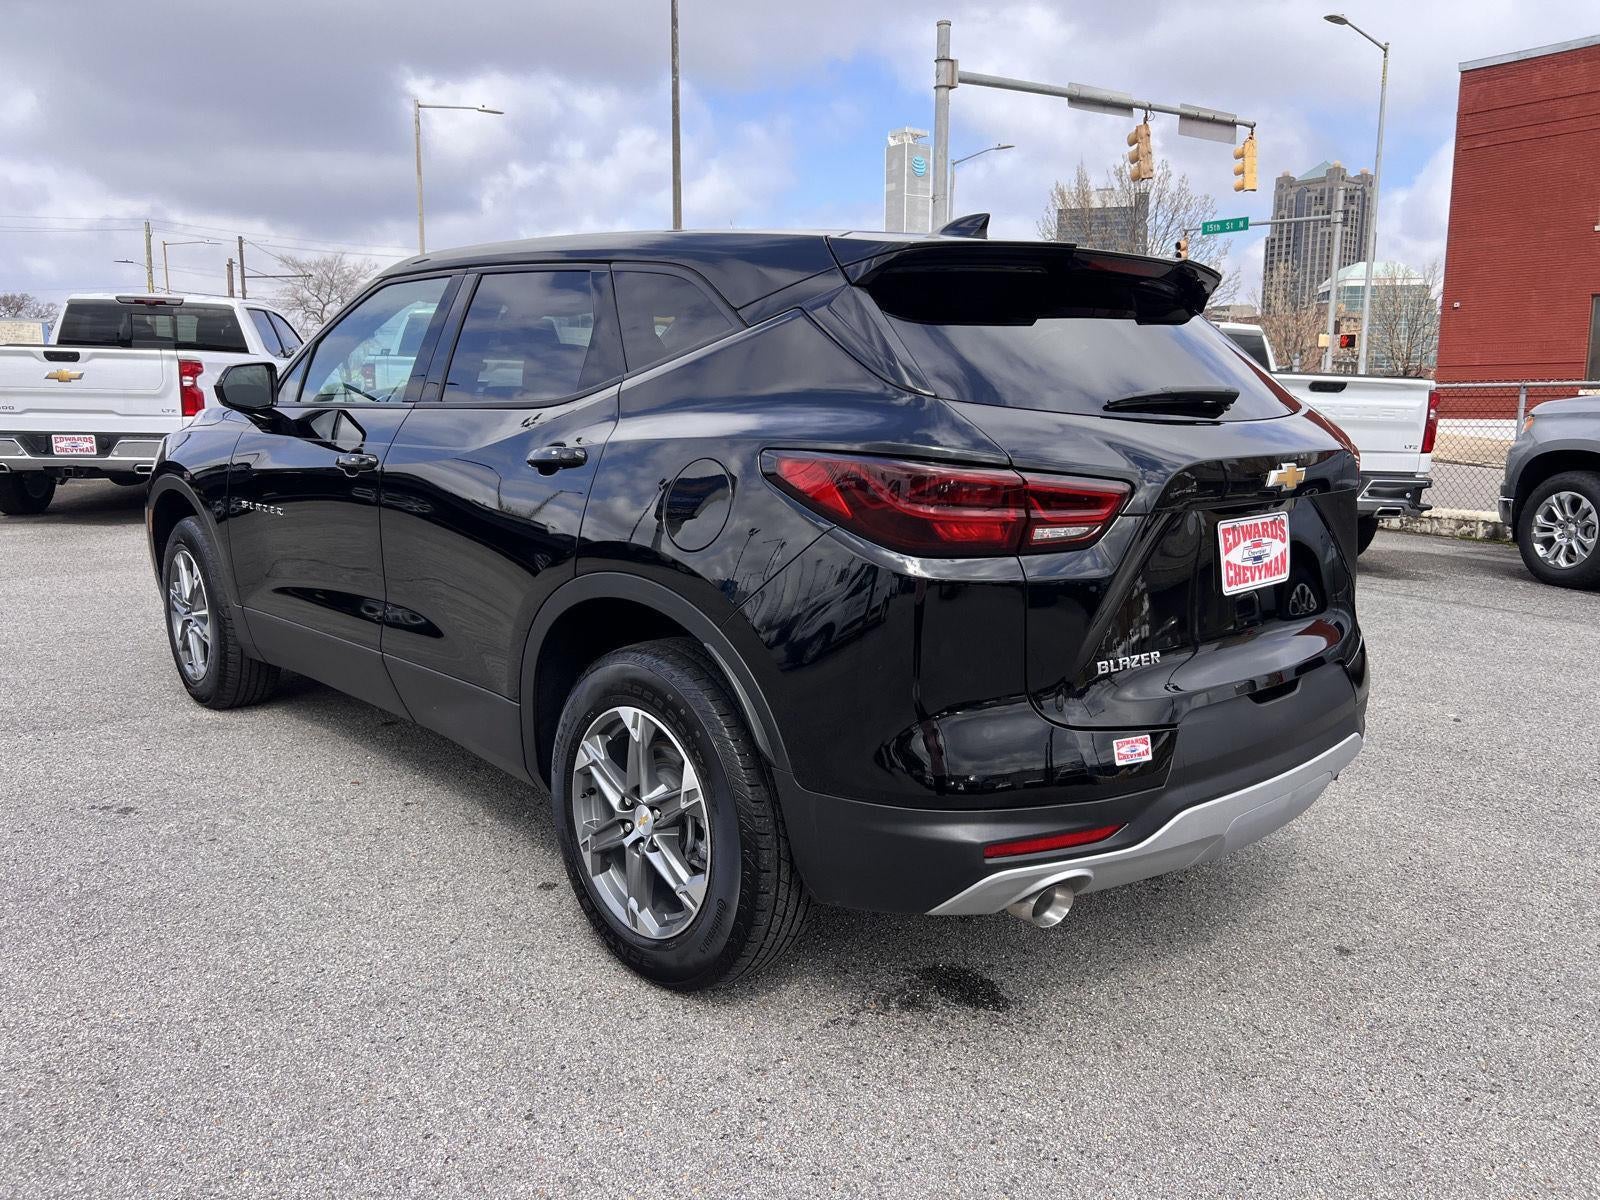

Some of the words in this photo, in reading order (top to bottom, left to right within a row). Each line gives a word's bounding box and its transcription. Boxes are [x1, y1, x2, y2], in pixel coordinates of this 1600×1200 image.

[1206, 224, 1221, 232] 15th
[1225, 221, 1234, 230] St
[1239, 220, 1244, 228] N
[53, 436, 94, 445] EDWARDS
[55, 445, 95, 454] CHEVYMAN
[1222, 518, 1286, 555] EDWARDS
[1225, 548, 1287, 588] CHEVYMAN
[1096, 650, 1161, 675] BLAZER
[1115, 737, 1149, 750] EDWARDS
[1117, 747, 1150, 761] CHEVYMAN
